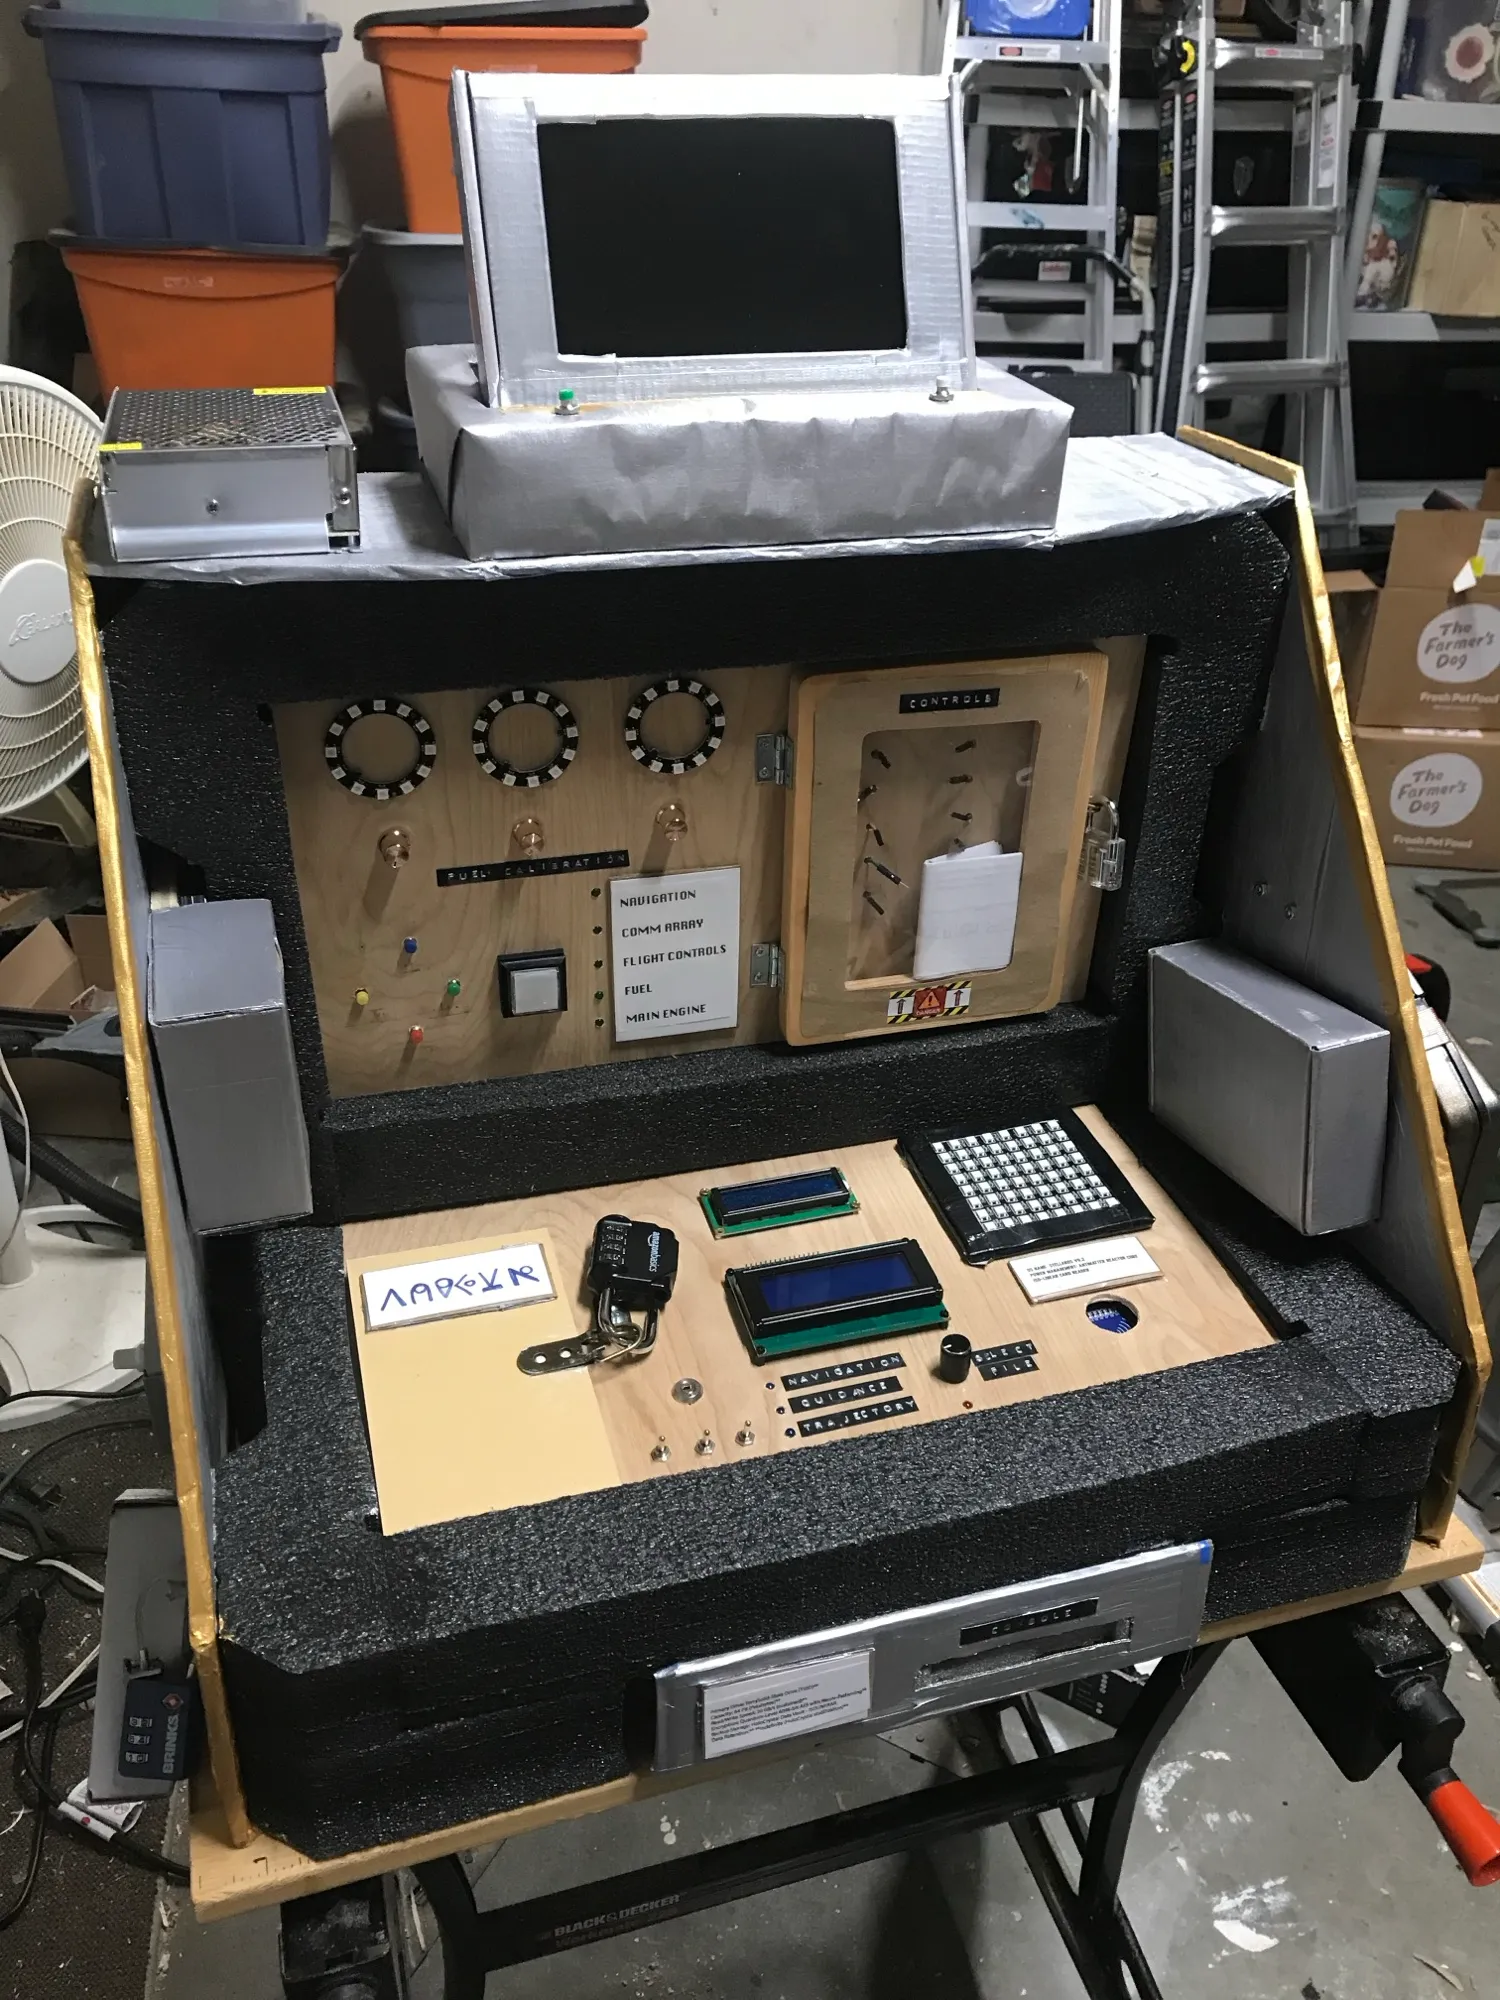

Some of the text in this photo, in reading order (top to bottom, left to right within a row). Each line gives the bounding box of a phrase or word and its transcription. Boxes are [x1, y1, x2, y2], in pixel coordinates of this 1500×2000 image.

[1439, 621, 1472, 636] The
[1424, 632, 1495, 655] Farmer's
[1436, 653, 1468, 670] Dog
[910, 694, 992, 709] CONTROLS
[1412, 768, 1444, 783] The
[1397, 780, 1468, 801] Farmer's
[1408, 800, 1441, 816] Dog
[504, 854, 626, 877] CALIBRATION
[620, 890, 697, 908] NAVIGATION
[621, 918, 704, 938] COMM ARRAY
[623, 944, 727, 967] FLIGHT CONTROLS
[624, 983, 653, 996] FUEL
[626, 1003, 707, 1024] MAIN ENGINE
[975, 1343, 1033, 1362] SELECT
[788, 1355, 900, 1386] NAVIGATION
[990, 1359, 1033, 1376] FILE
[801, 1381, 888, 1408] GUIDANCE
[803, 1400, 915, 1432] TRAJECTORY
[162, 1714, 180, 1773] BRINKS
